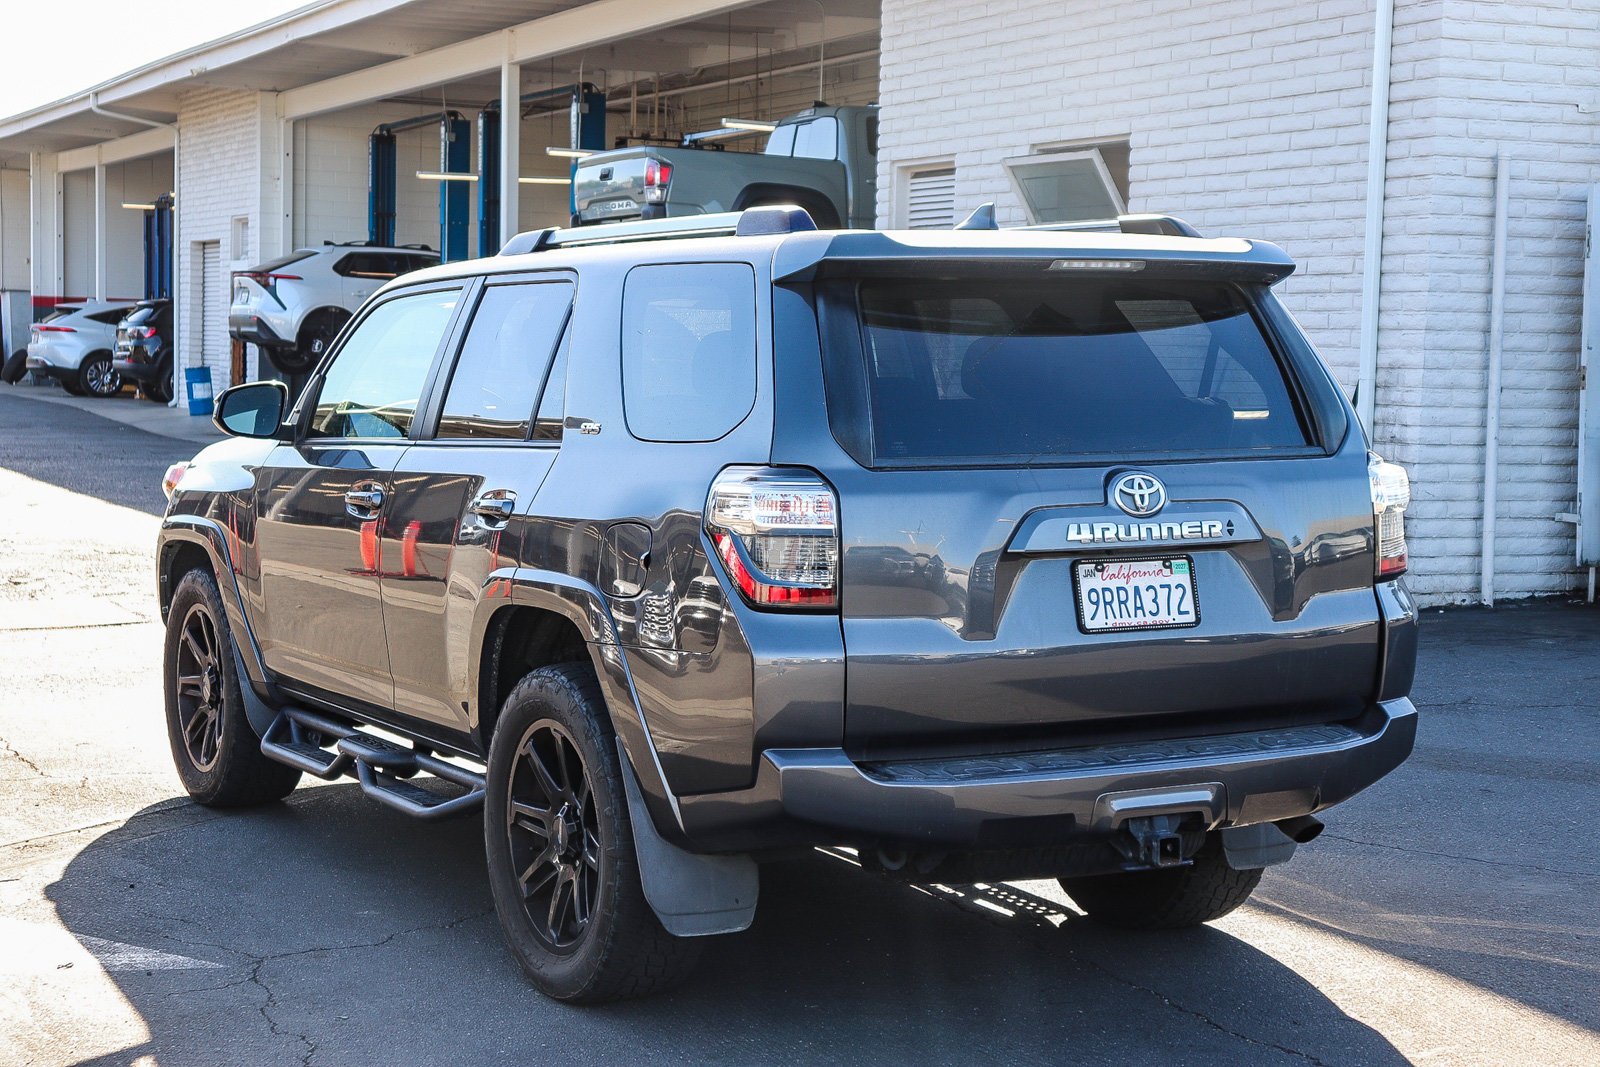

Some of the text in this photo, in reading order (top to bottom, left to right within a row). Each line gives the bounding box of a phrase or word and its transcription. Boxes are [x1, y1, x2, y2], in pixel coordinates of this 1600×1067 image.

[1067, 521, 1223, 543] 4RUNNER
[1083, 568, 1096, 578] JAN
[1100, 564, 1171, 585] California
[1088, 583, 1190, 620] 9RRA372
